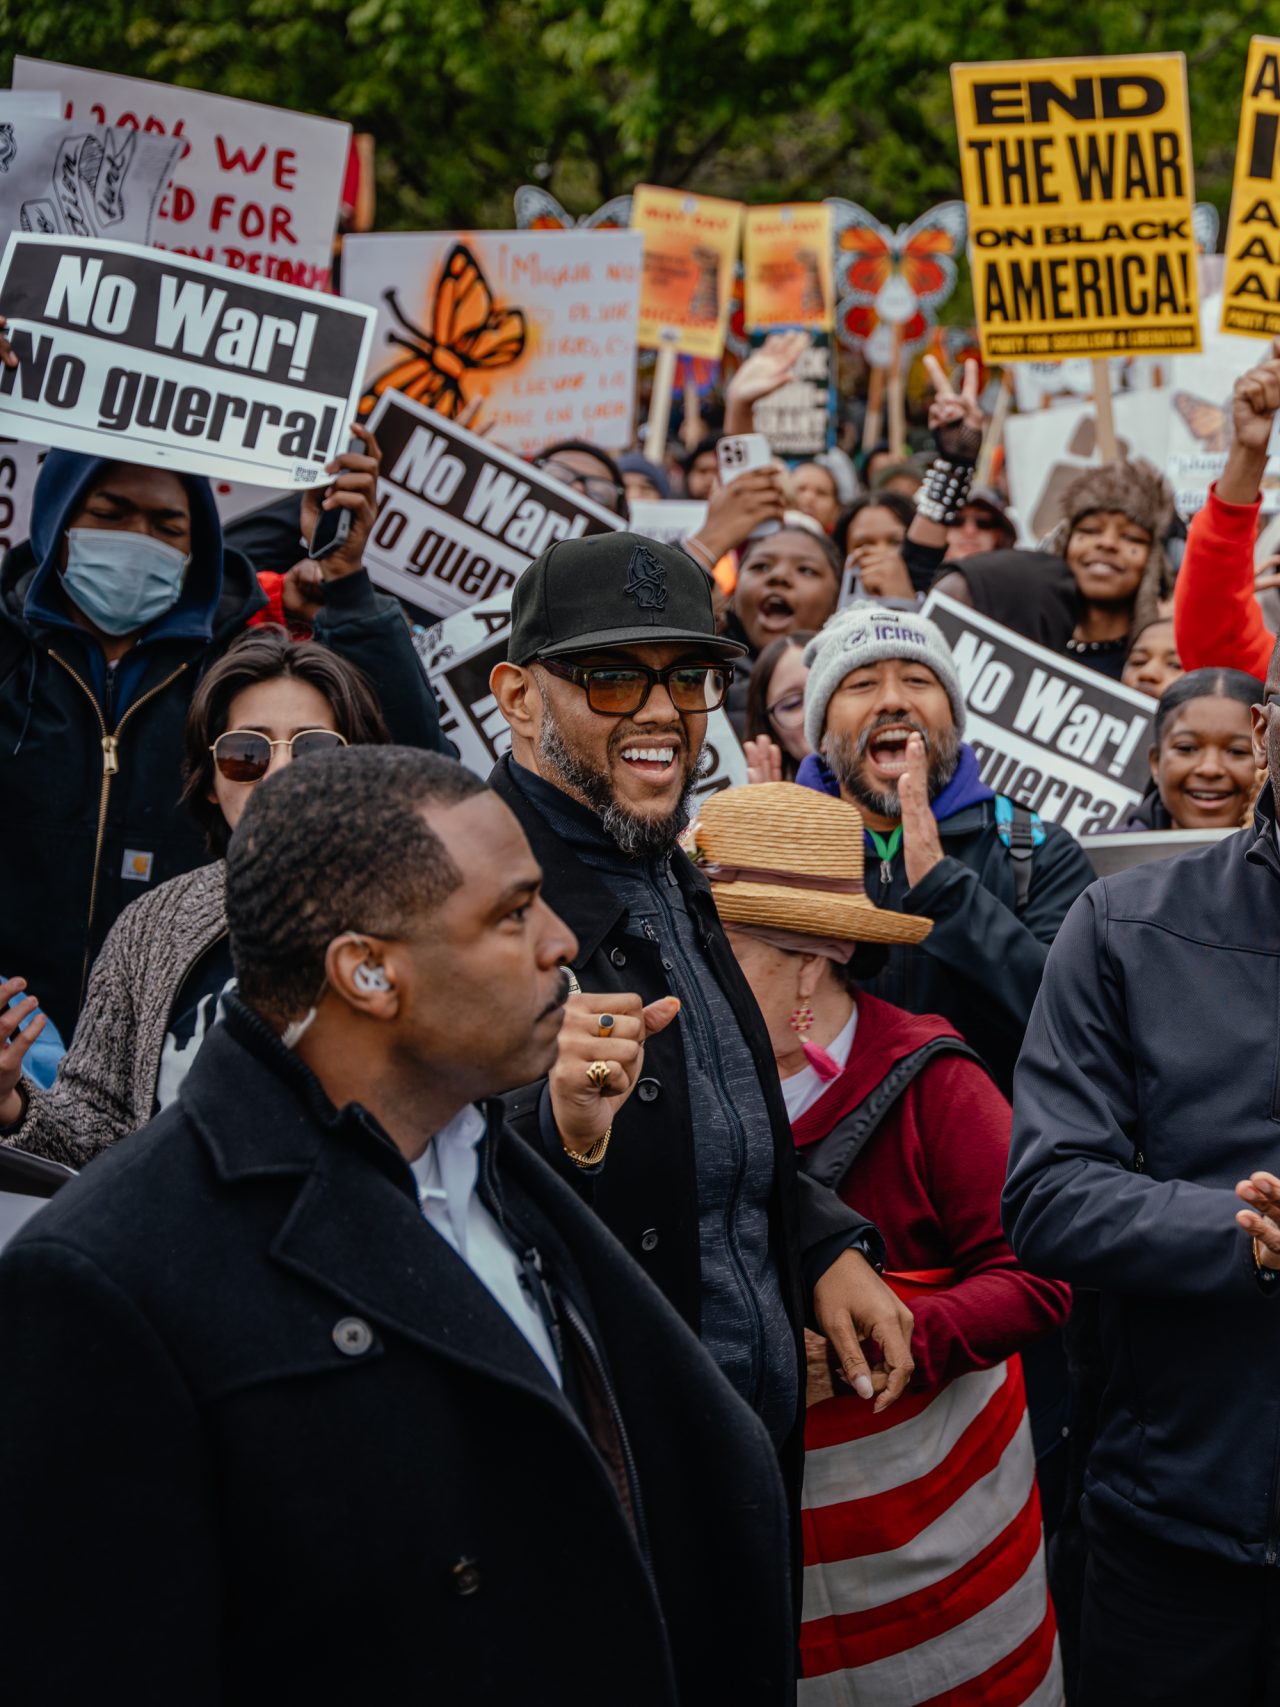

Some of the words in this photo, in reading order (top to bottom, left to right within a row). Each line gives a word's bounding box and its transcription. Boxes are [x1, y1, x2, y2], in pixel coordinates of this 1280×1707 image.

[974, 76, 1165, 124] END
[215, 135, 298, 190] WE
[968, 136, 1060, 206] THE
[1067, 131, 1185, 201] WAR
[209, 194, 299, 244] FOR
[976, 228, 1033, 247] ON
[1045, 219, 1188, 245] BLACK
[43, 255, 137, 335] No
[155, 273, 319, 383] War!
[985, 253, 1191, 322] AMERICA!
[0, 327, 86, 408] No
[98, 367, 337, 464] guerra!
[389, 425, 467, 505] No
[951, 630, 1014, 714] No
[1013, 668, 1149, 777] War!
